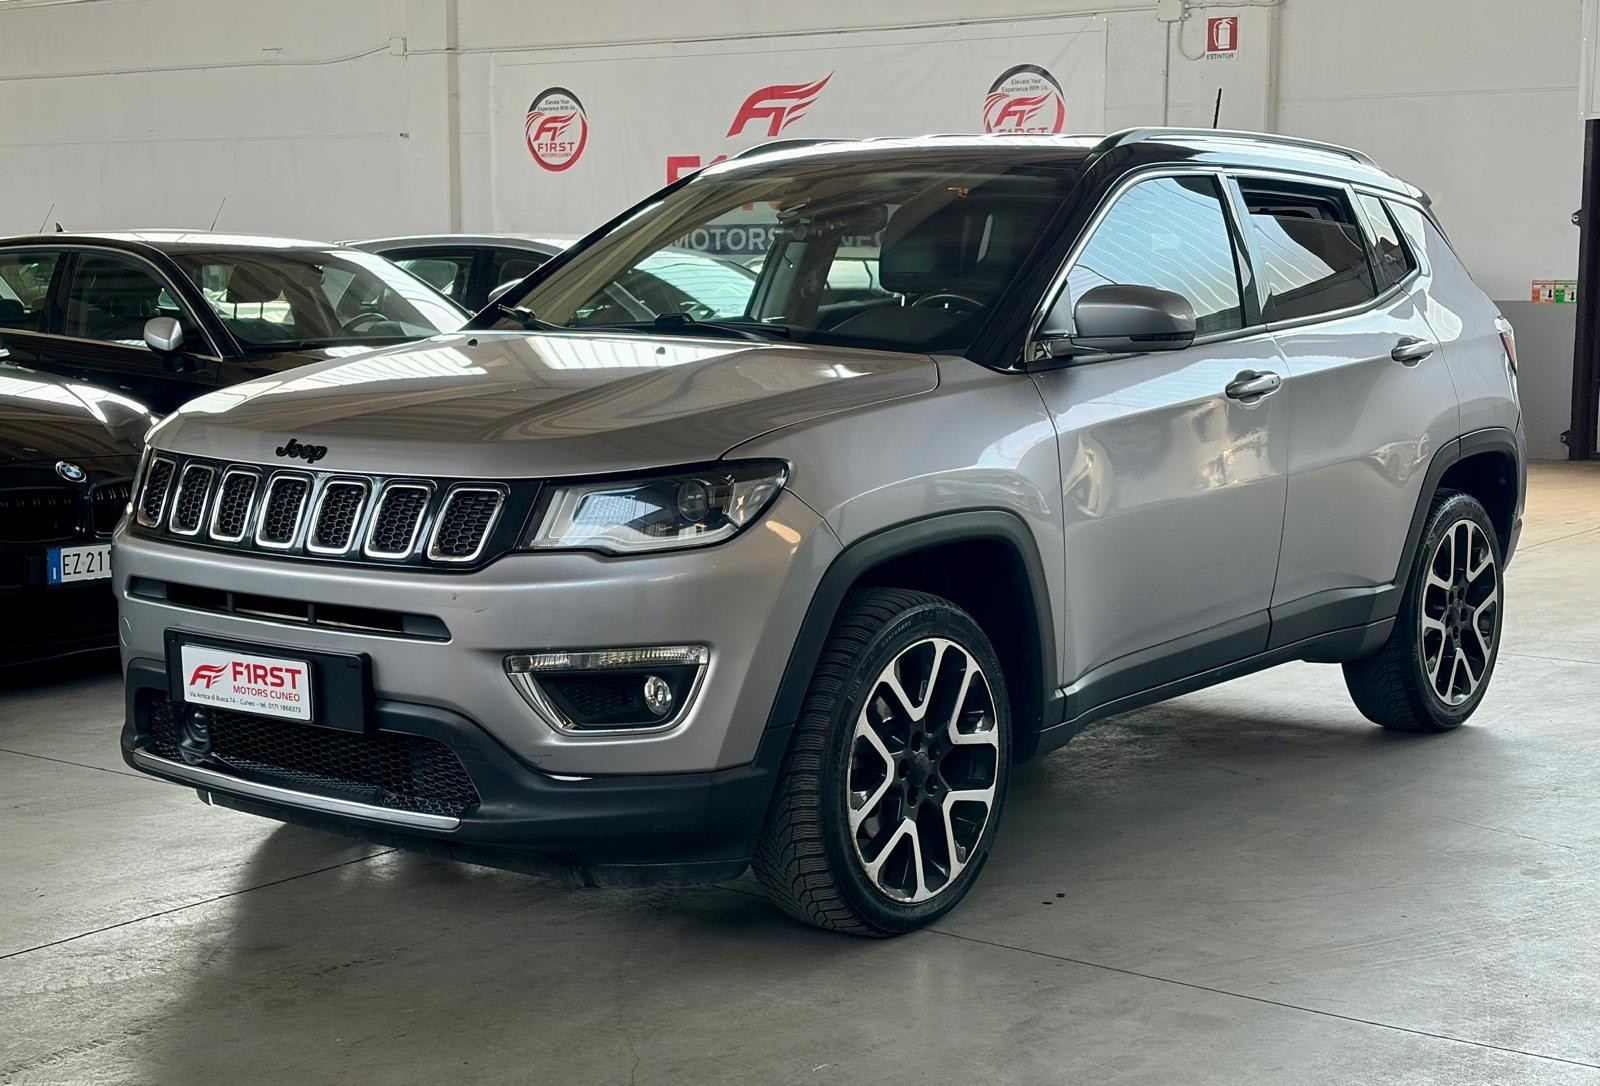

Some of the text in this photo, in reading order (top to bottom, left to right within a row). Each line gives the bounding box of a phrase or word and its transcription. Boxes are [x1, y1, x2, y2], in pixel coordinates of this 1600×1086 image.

[275, 438, 328, 464] Jeep
[62, 553, 82, 576] EZ
[189, 690, 197, 698] Via
[233, 685, 301, 702] MOTORS CUNEO
